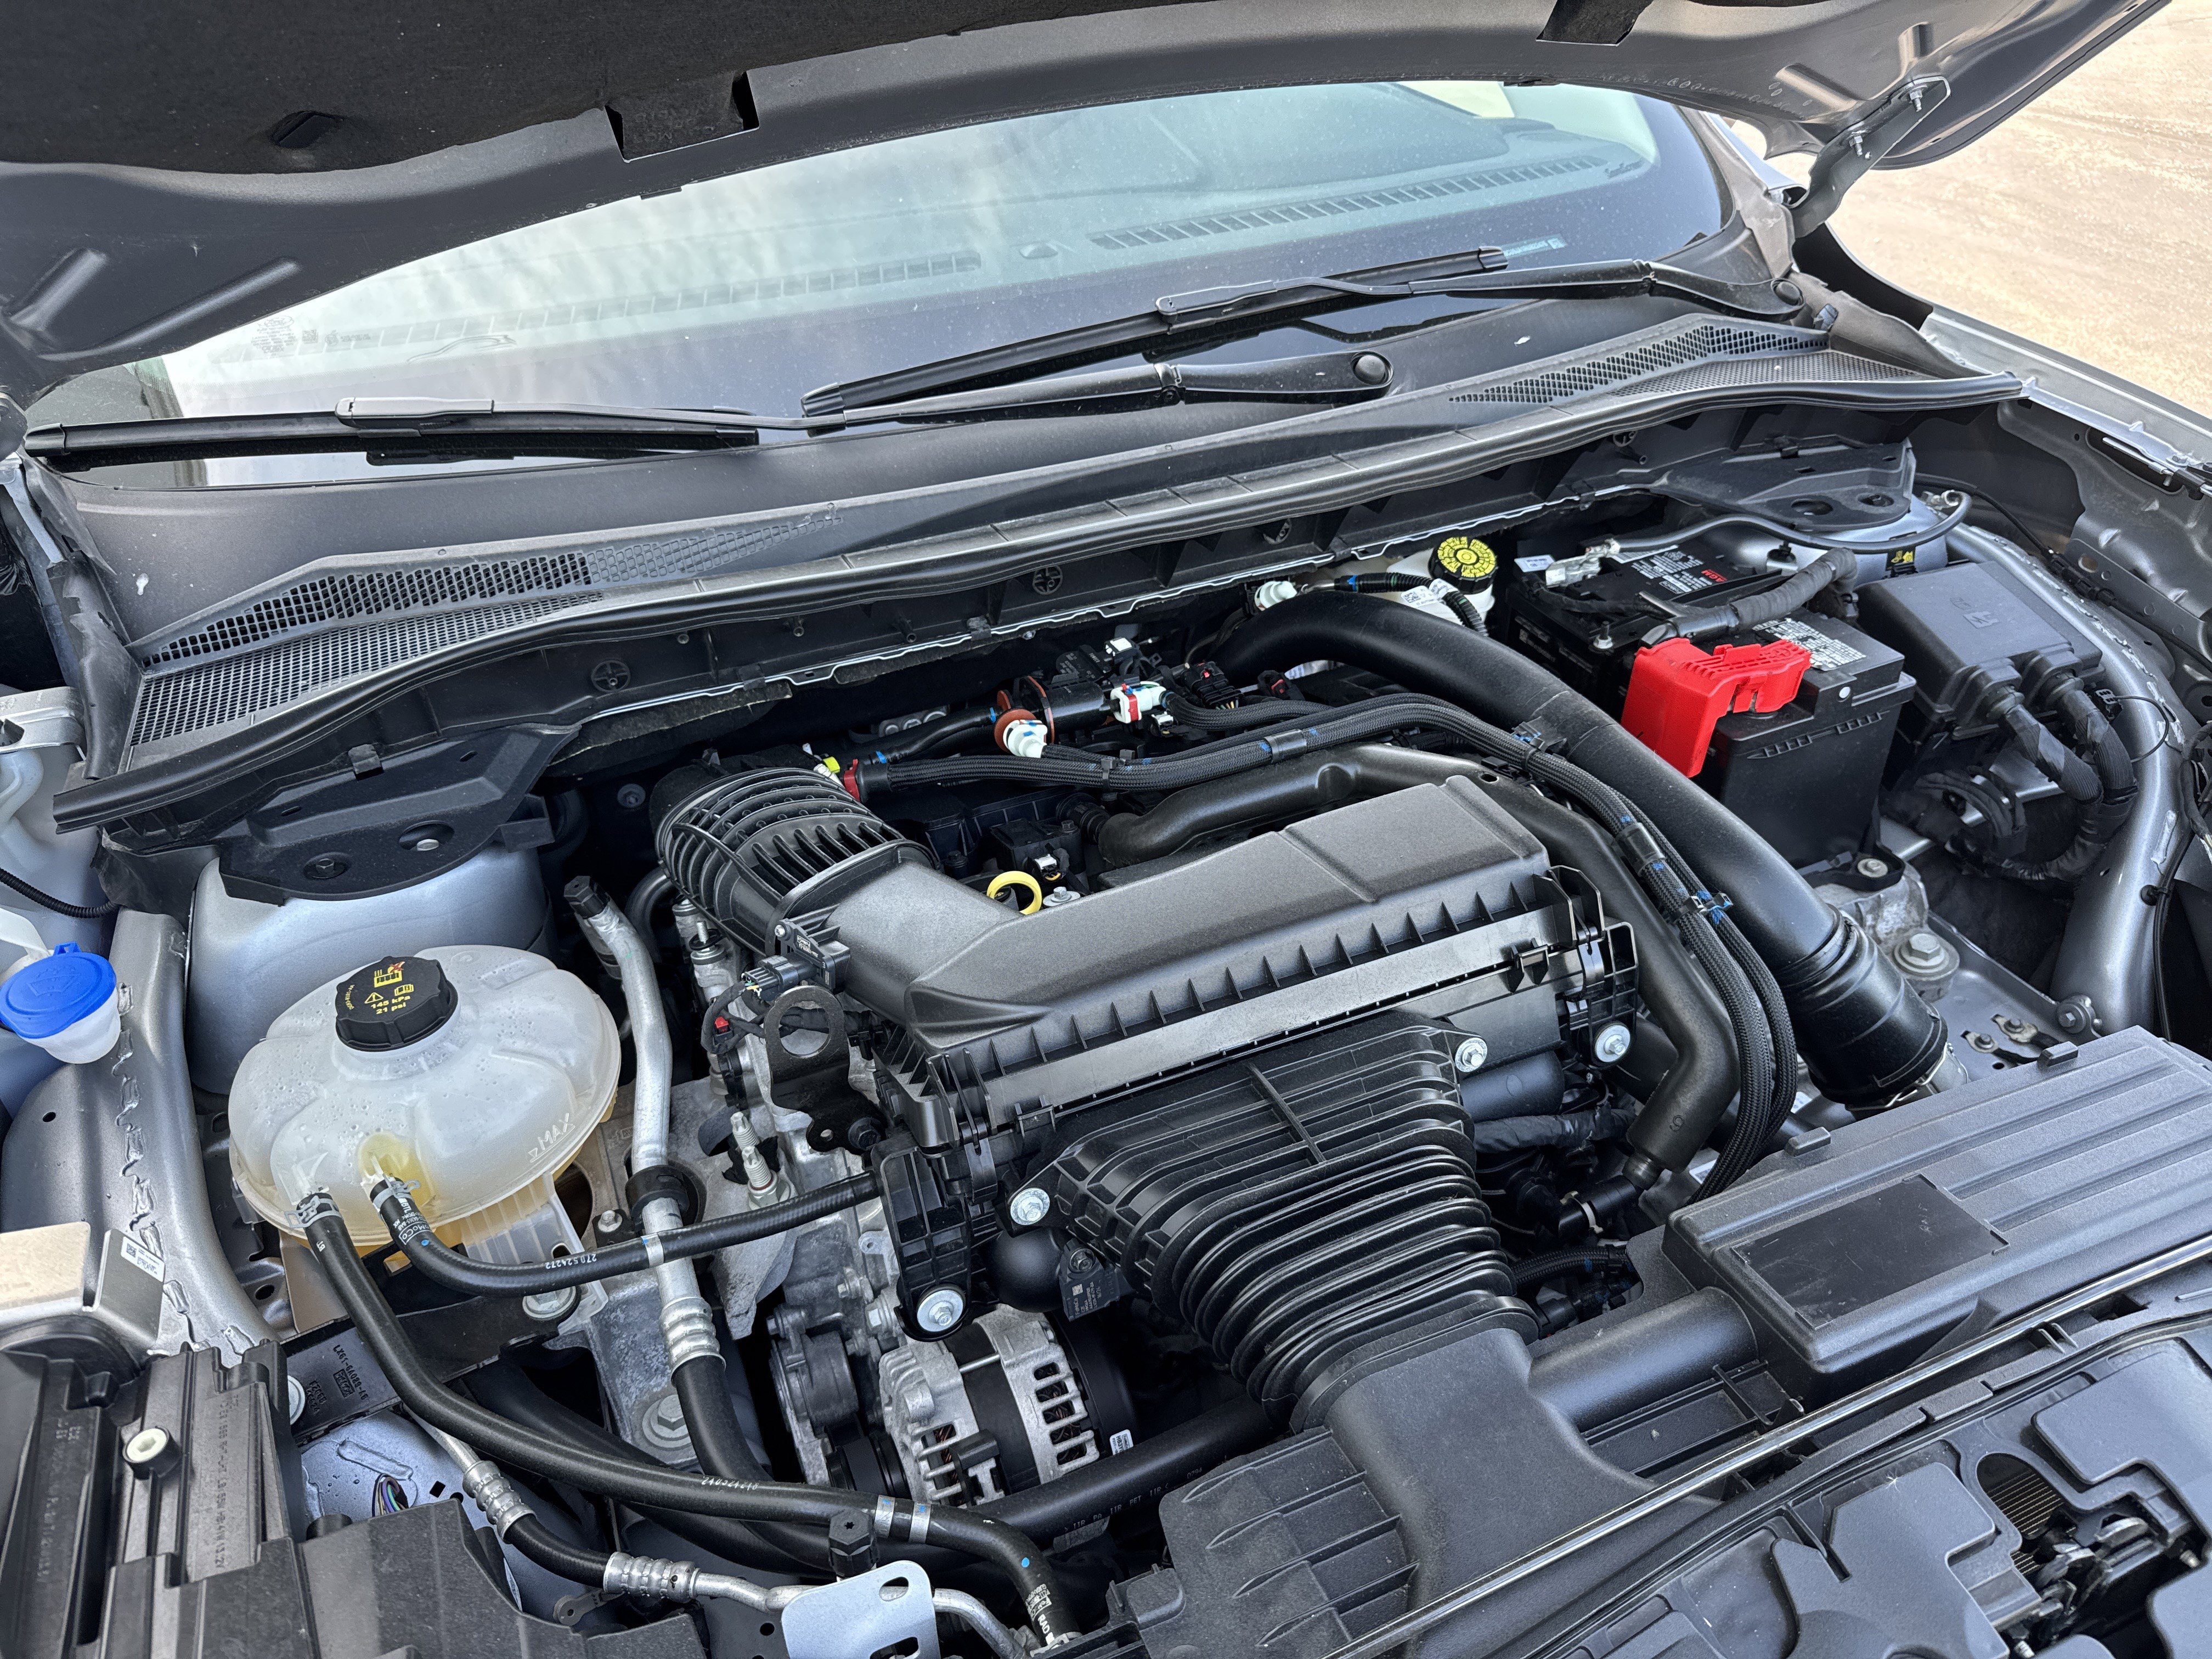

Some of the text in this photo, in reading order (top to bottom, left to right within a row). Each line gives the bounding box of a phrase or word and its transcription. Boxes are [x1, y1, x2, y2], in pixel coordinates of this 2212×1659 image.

[1701, 569, 1724, 583] AGM
[371, 1001, 389, 1009] 145
[392, 1003, 406, 1012] psi
[538, 1113, 568, 1150] MAX
[401, 1201, 412, 1214] BTL
[1128, 1495, 1143, 1506] PET
[1037, 1613, 1051, 1634] RAD
